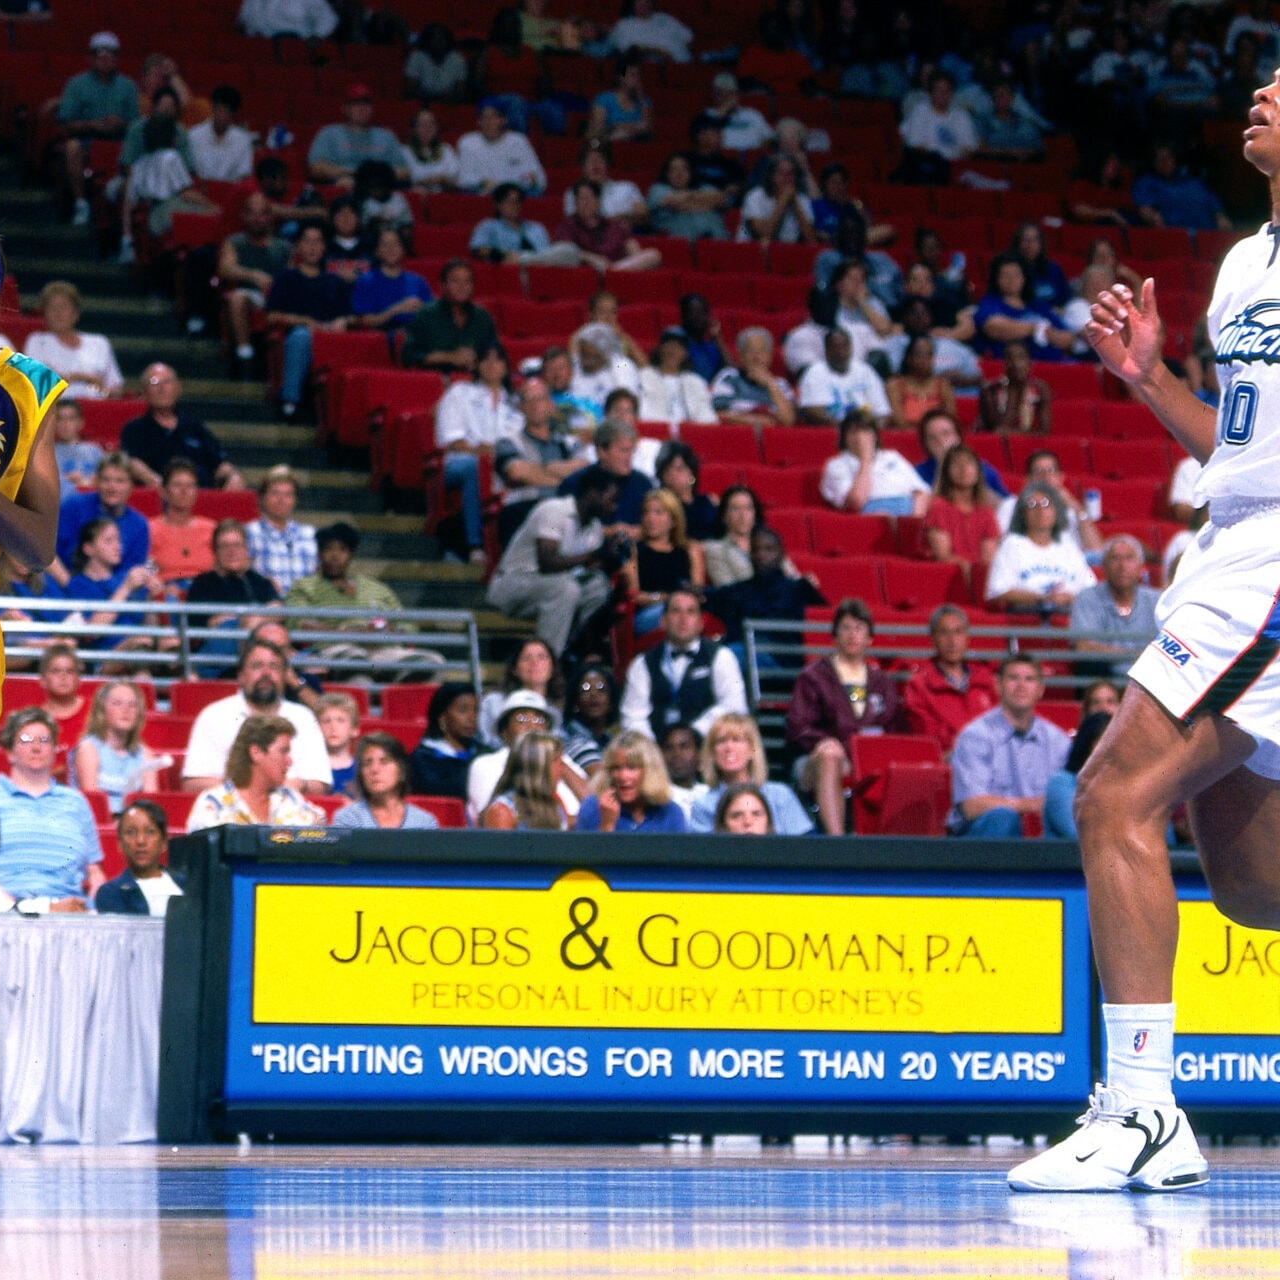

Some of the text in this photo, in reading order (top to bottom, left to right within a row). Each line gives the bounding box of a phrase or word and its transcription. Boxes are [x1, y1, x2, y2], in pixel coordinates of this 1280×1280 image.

[1157, 634, 1192, 666] NBA
[329, 910, 531, 967] JACOBS
[560, 896, 613, 971] &
[411, 982, 924, 1018] PERSONAL INJURY ATTORNEYS
[252, 1044, 1066, 1082] "RIGHTING WRONGS FOR MORE THAN 20 YEARS"
